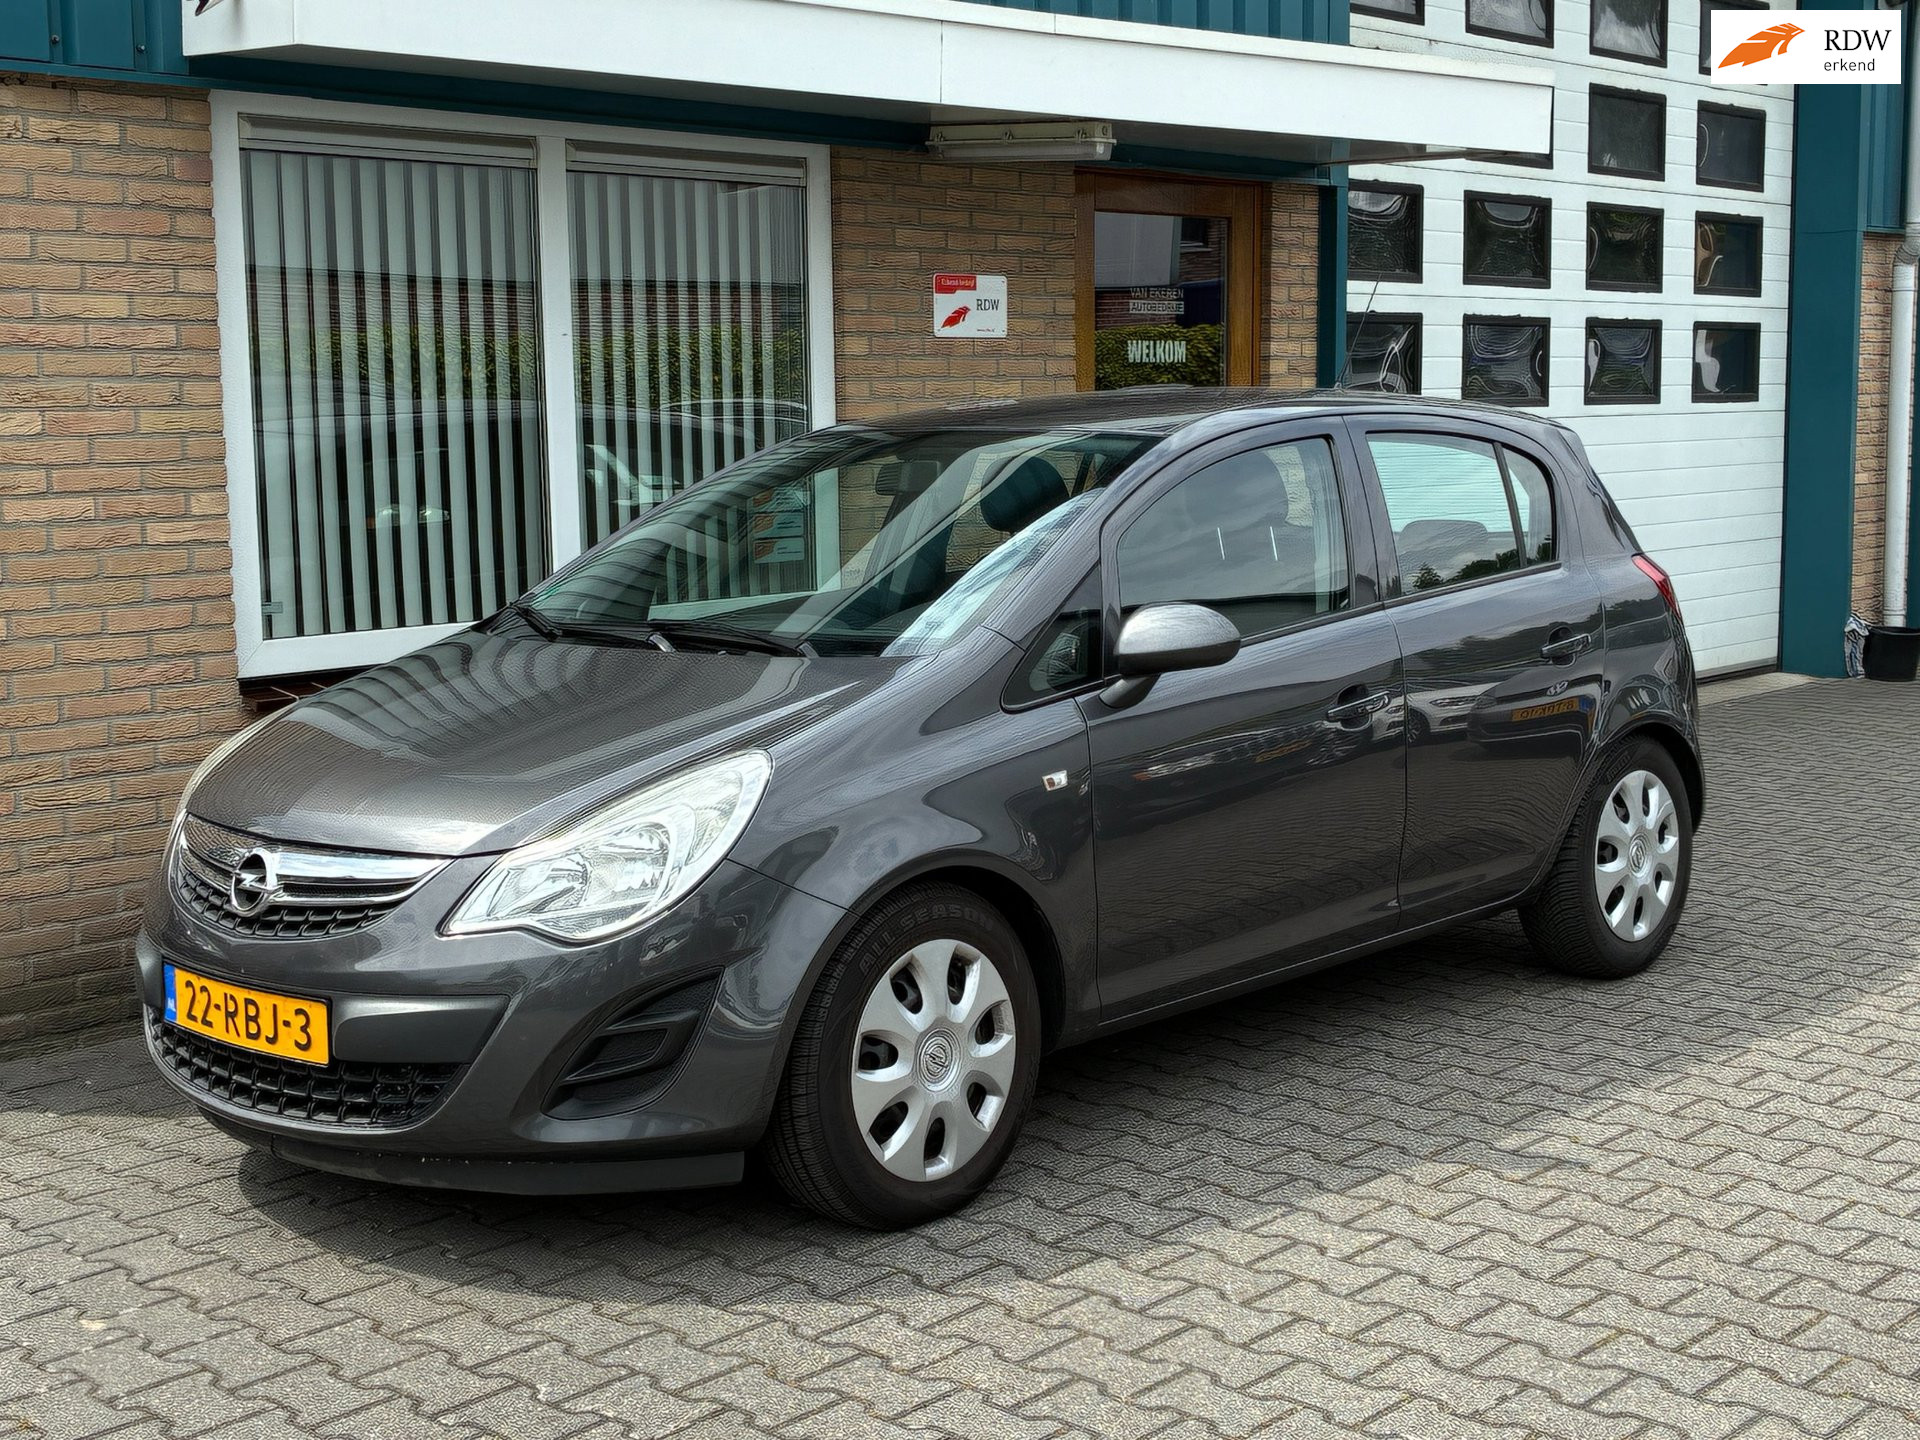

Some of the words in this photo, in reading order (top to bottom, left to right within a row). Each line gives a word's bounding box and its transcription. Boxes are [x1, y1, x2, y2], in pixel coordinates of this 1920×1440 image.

[1130, 287, 1148, 299] VAN
[976, 299, 1000, 311] RDW
[1127, 340, 1187, 363] WELKOM
[859, 931, 896, 974] ALL
[184, 980, 312, 1051] 22-RBJ-3
